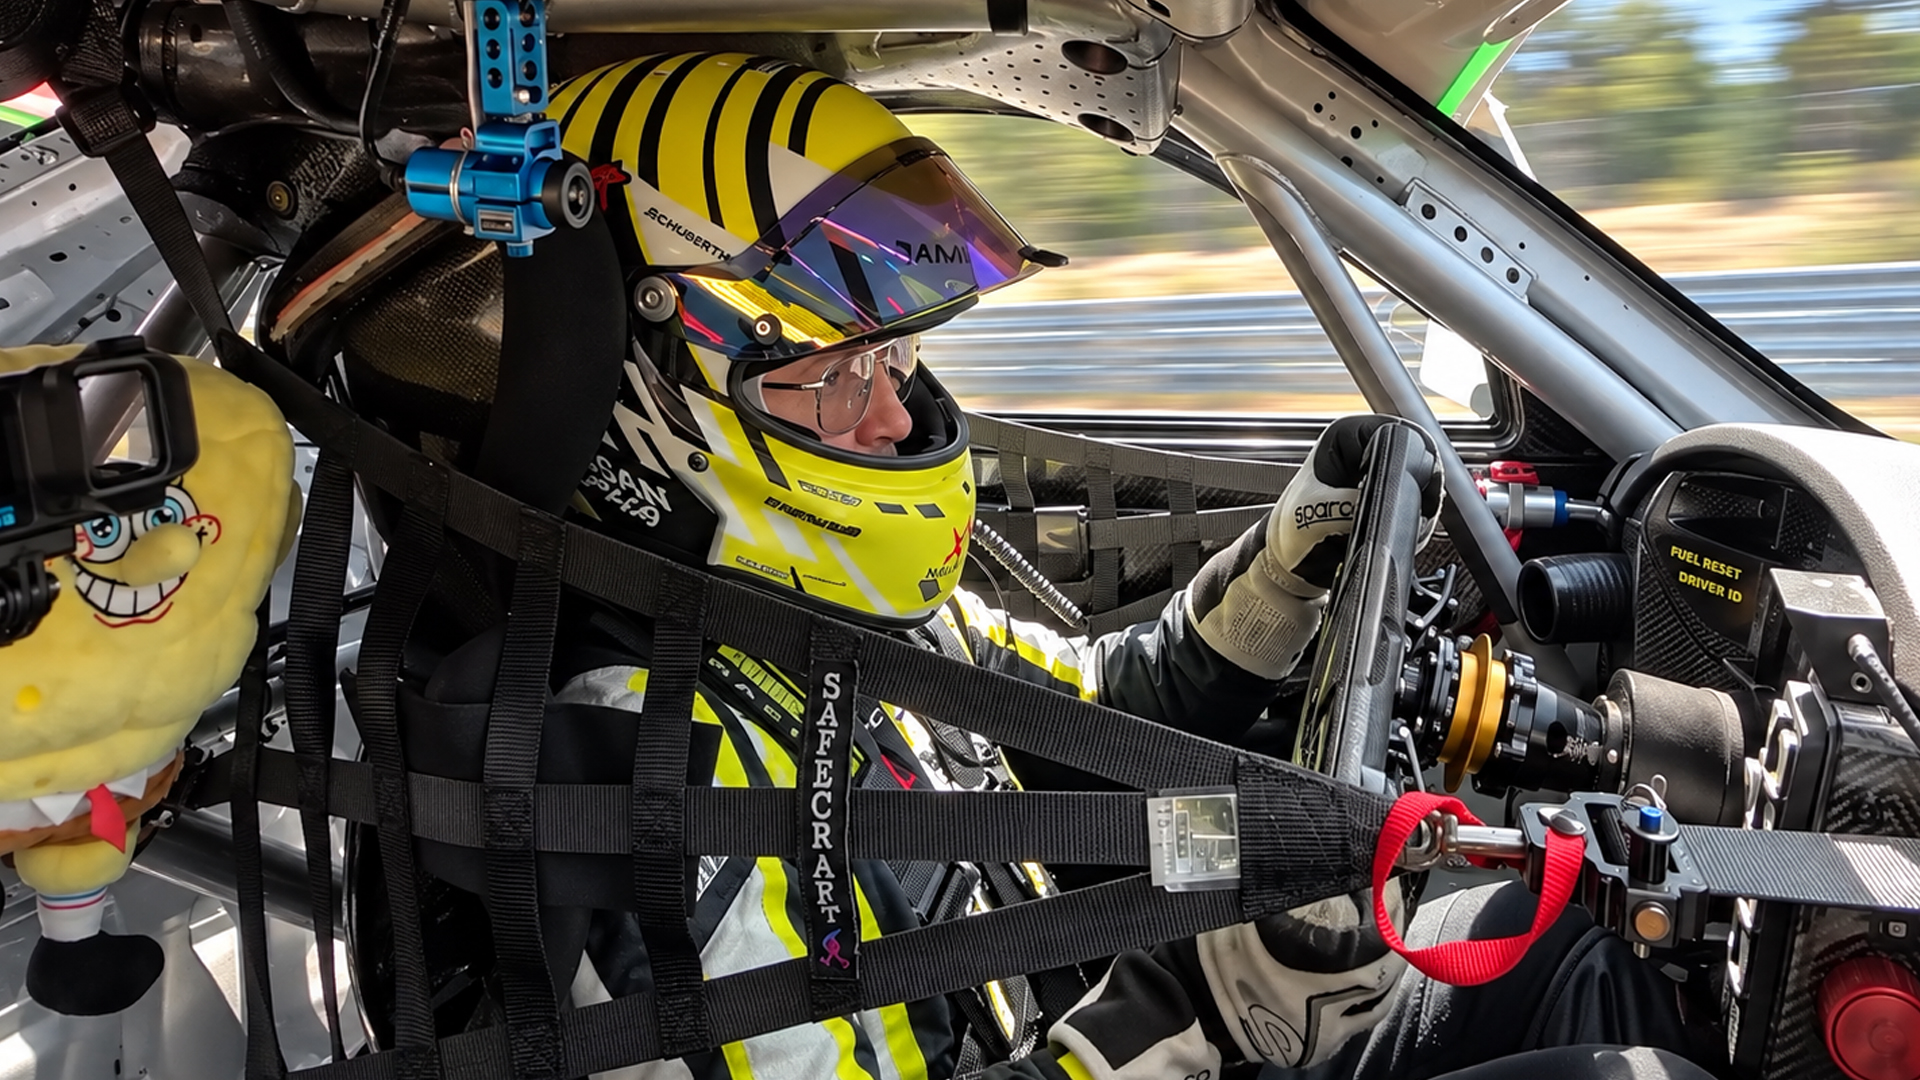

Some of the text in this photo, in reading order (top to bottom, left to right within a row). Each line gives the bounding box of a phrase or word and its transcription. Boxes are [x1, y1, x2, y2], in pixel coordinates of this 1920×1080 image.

[643, 202, 731, 261] SCHUBERTH
[1295, 500, 1355, 529] sparc
[1670, 545, 1742, 581] FUEL RESET
[1678, 570, 1743, 603] DRIVER ID
[810, 672, 841, 924] SAFECRART
